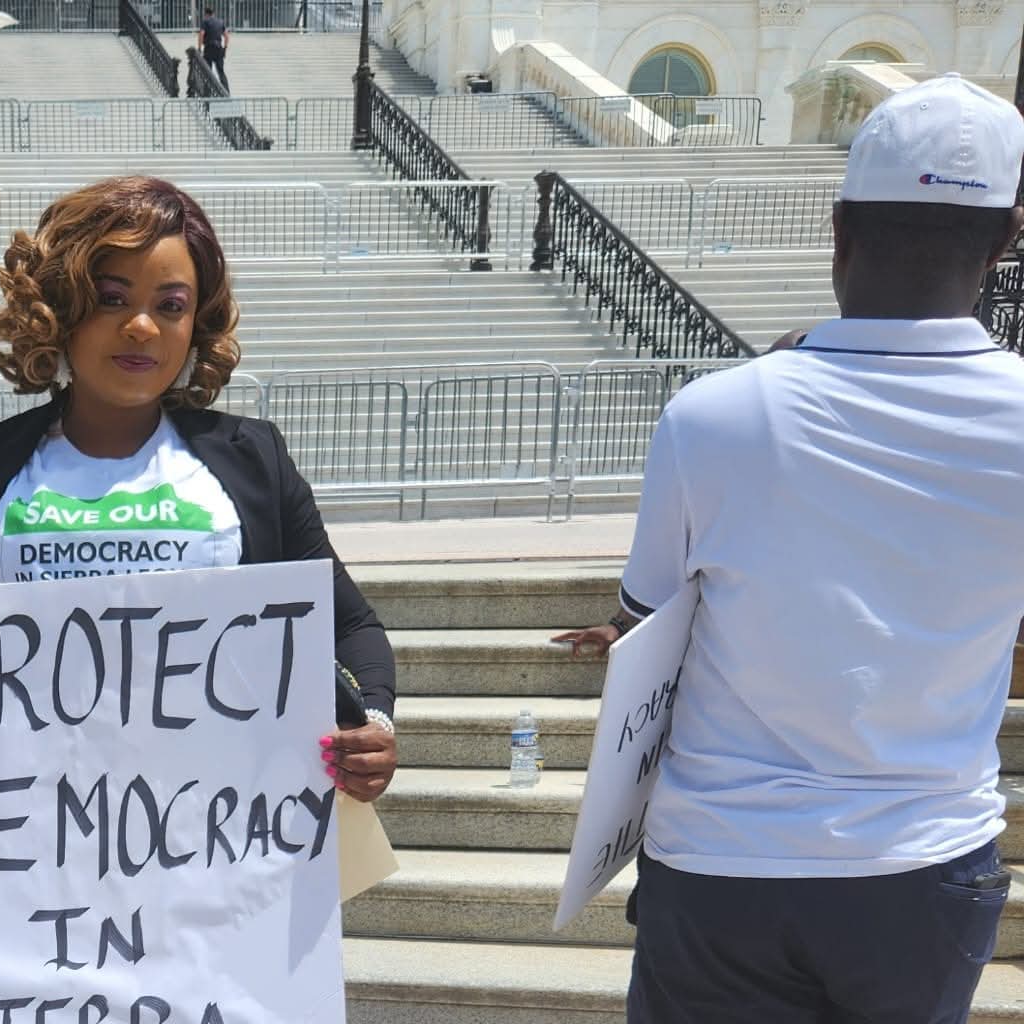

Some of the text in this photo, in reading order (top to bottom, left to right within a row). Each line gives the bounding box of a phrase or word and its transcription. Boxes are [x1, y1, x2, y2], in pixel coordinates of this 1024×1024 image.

[919, 173, 988, 190] Champion
[23, 499, 180, 525] SAVE OUR
[19, 540, 189, 565] DEMOCRACY
[15, 571, 33, 583] IN
[28, 905, 146, 970] IN
